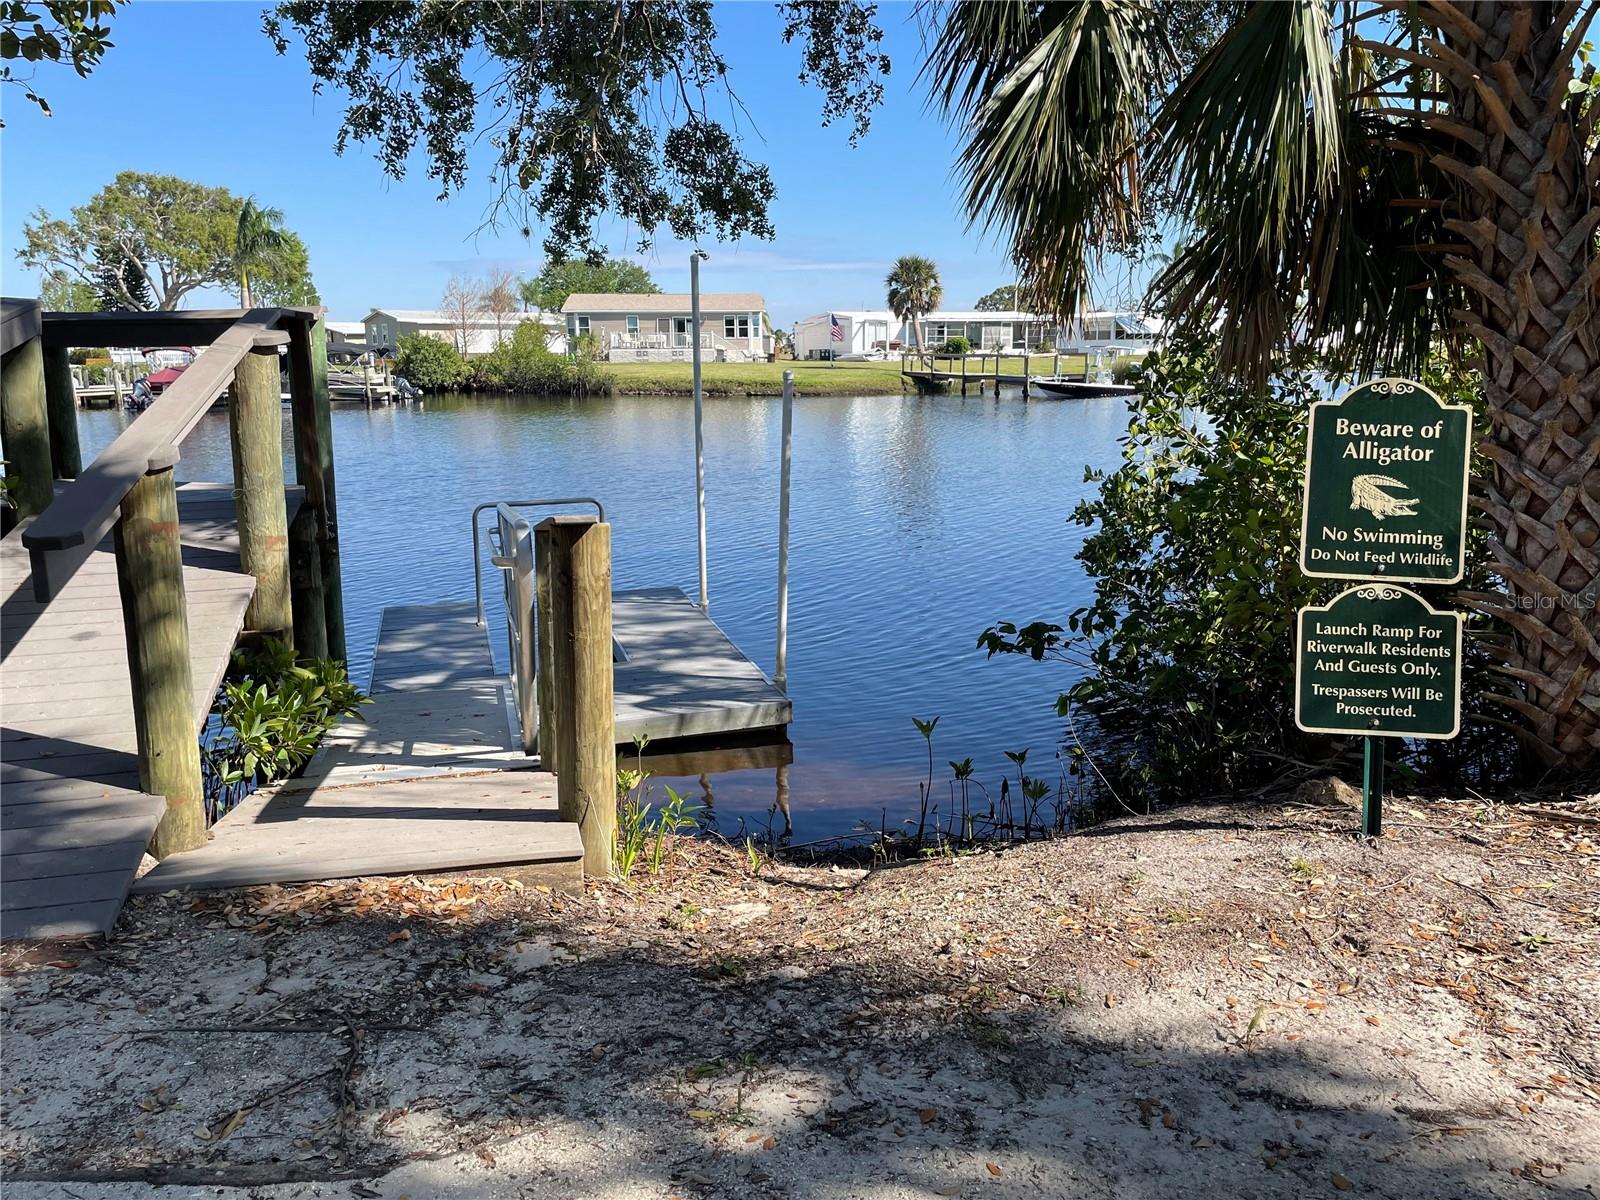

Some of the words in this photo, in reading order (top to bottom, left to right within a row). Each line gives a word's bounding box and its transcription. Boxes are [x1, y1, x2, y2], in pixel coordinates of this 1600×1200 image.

[1336, 419, 1414, 438] Beware
[1421, 420, 1444, 439] of
[1342, 441, 1434, 465] Alligator
[1322, 526, 1348, 542] No
[1353, 527, 1444, 550] Swimming
[1311, 549, 1331, 561] Do
[1335, 549, 1359, 562] Not
[1364, 550, 1396, 564] Feed
[1399, 551, 1453, 567] Wildlife
[1316, 622, 1368, 636] Launch
[1372, 624, 1413, 641] Ramp
[1418, 626, 1442, 639] For
[1307, 639, 1377, 655] Riverwalk
[1382, 642, 1451, 658] Residents
[1314, 659, 1343, 672] And
[1348, 660, 1397, 674] Guests
[1402, 662, 1441, 679] Only.
[1312, 684, 1388, 702] Trespassers
[1392, 686, 1420, 701] Will
[1425, 688, 1443, 701] Be
[1336, 702, 1417, 718] Prosecuted.
